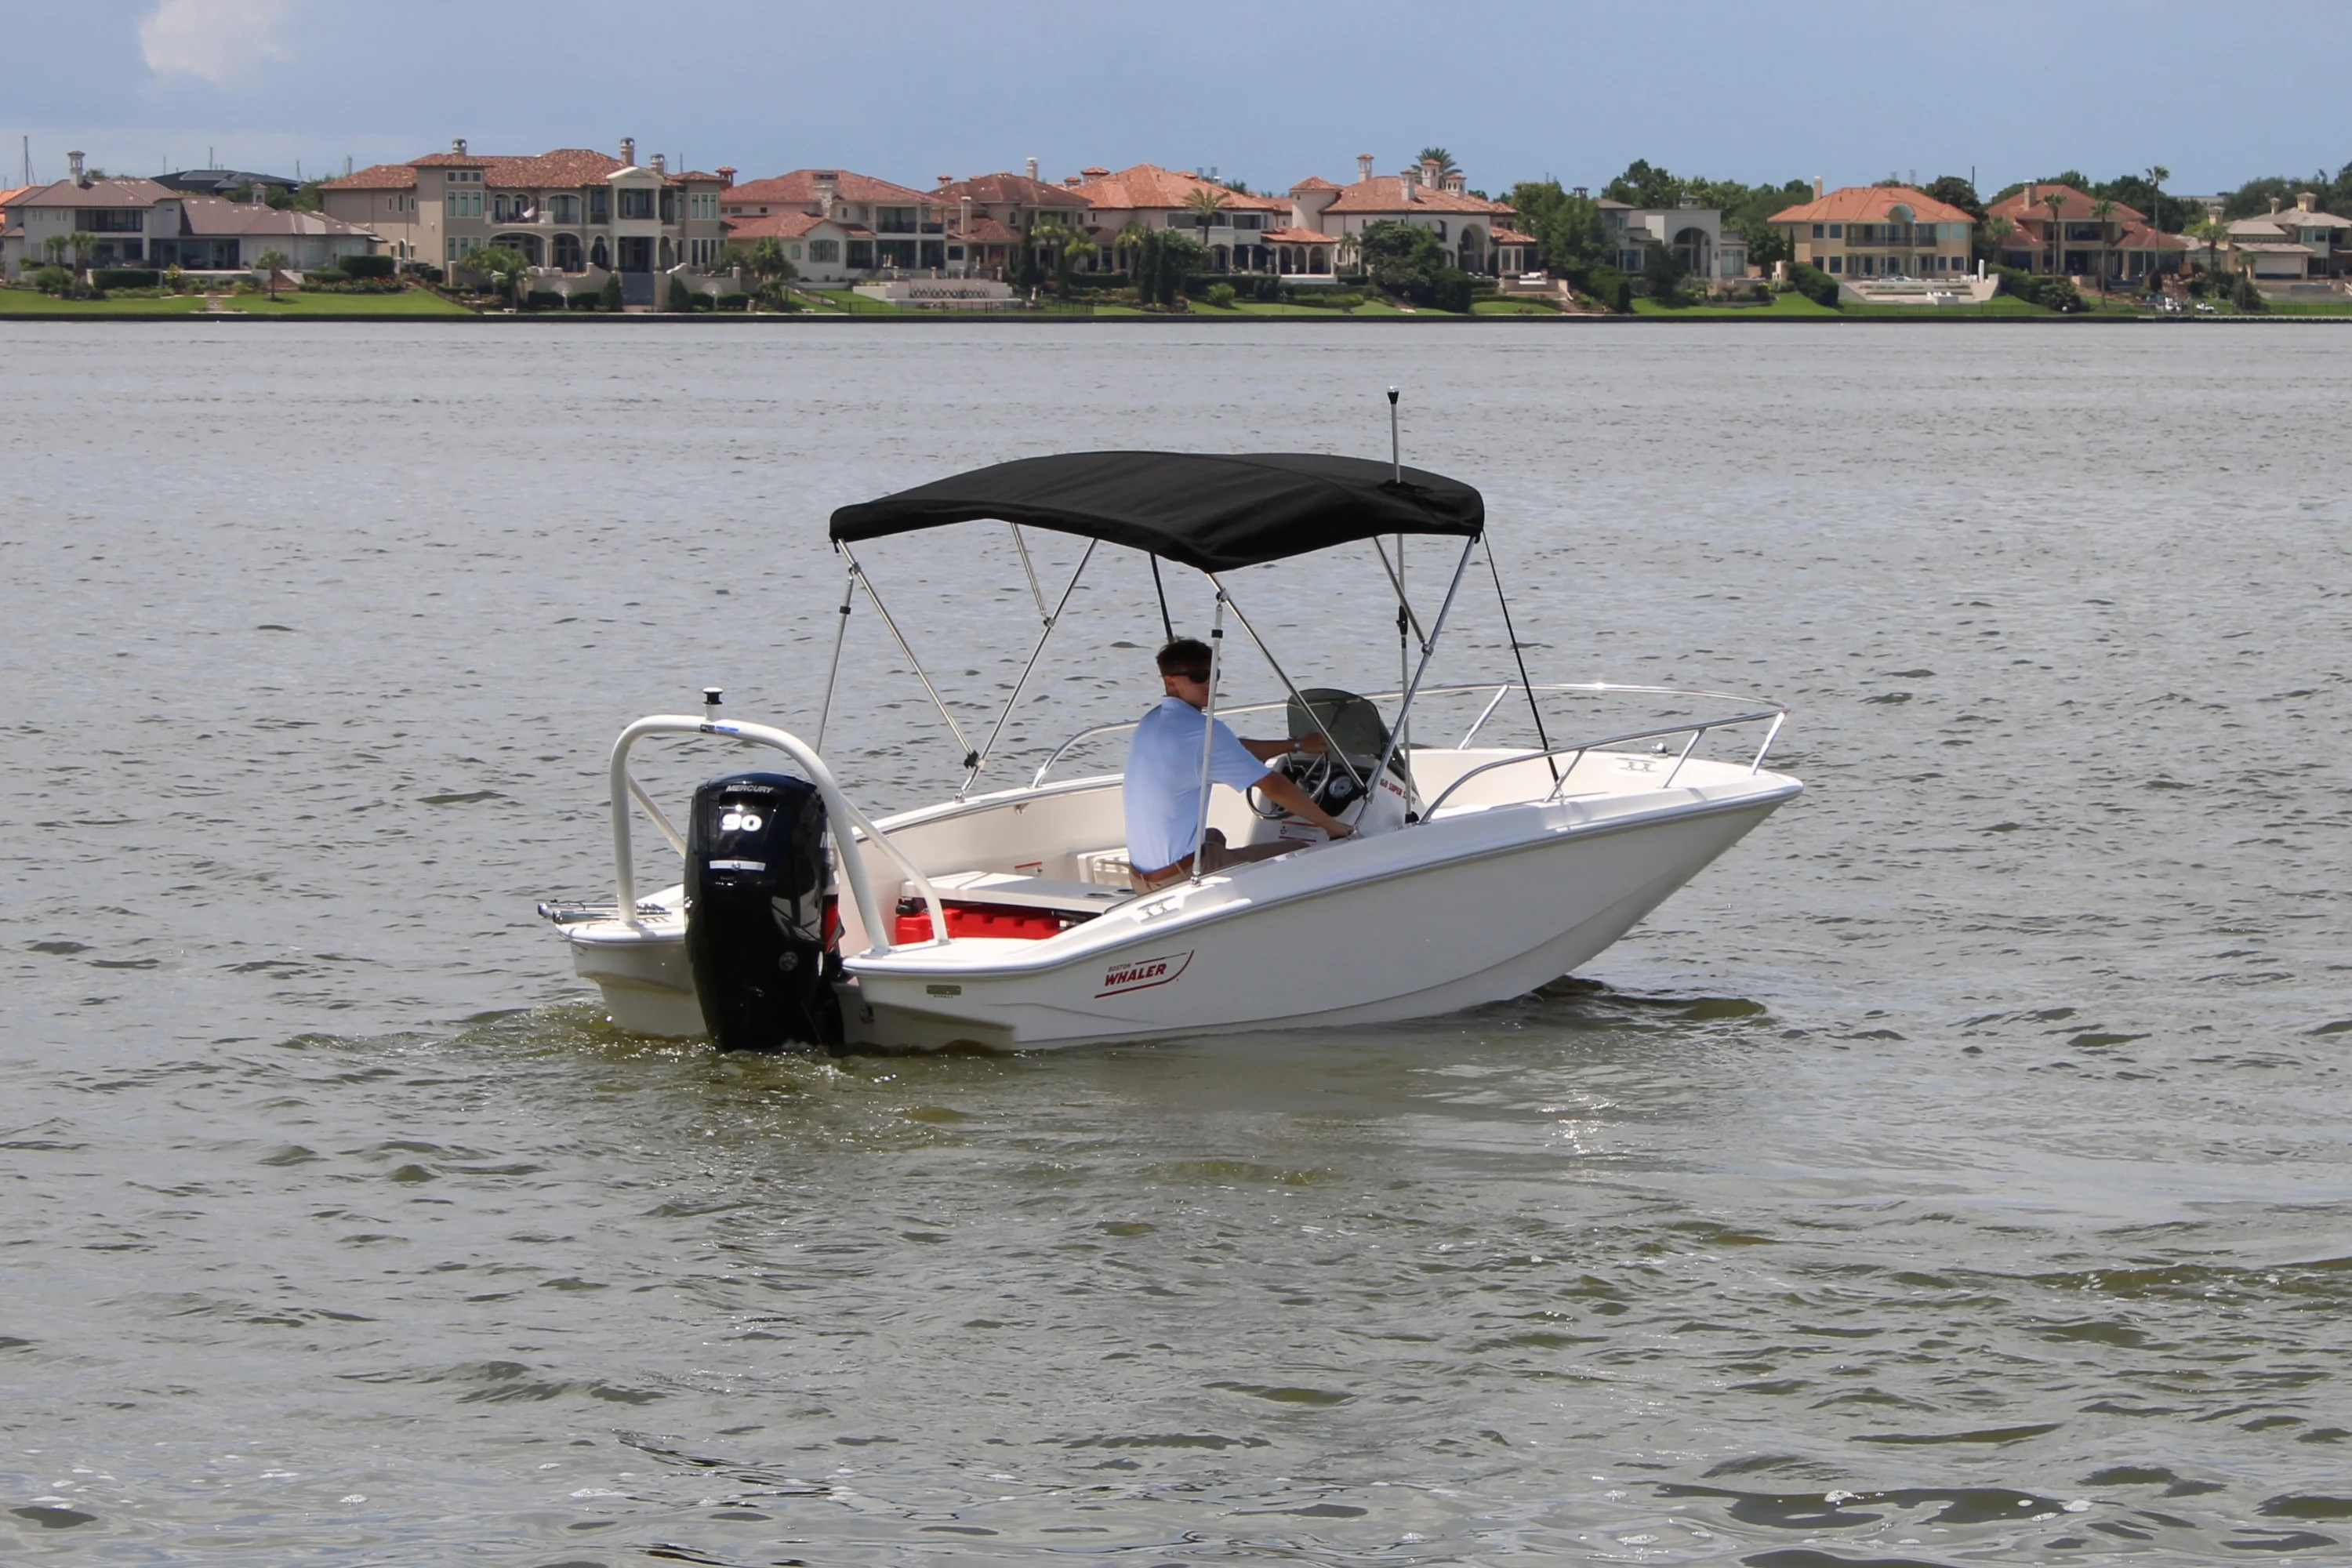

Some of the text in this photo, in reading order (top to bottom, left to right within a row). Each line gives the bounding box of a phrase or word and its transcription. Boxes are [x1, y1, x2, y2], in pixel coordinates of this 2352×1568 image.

[725, 785, 774, 793] MERCURY
[1388, 782, 1403, 796] SUPER
[721, 813, 762, 832] 90
[1105, 963, 1167, 986] WHALER
[1108, 963, 1131, 972] BOSTON
